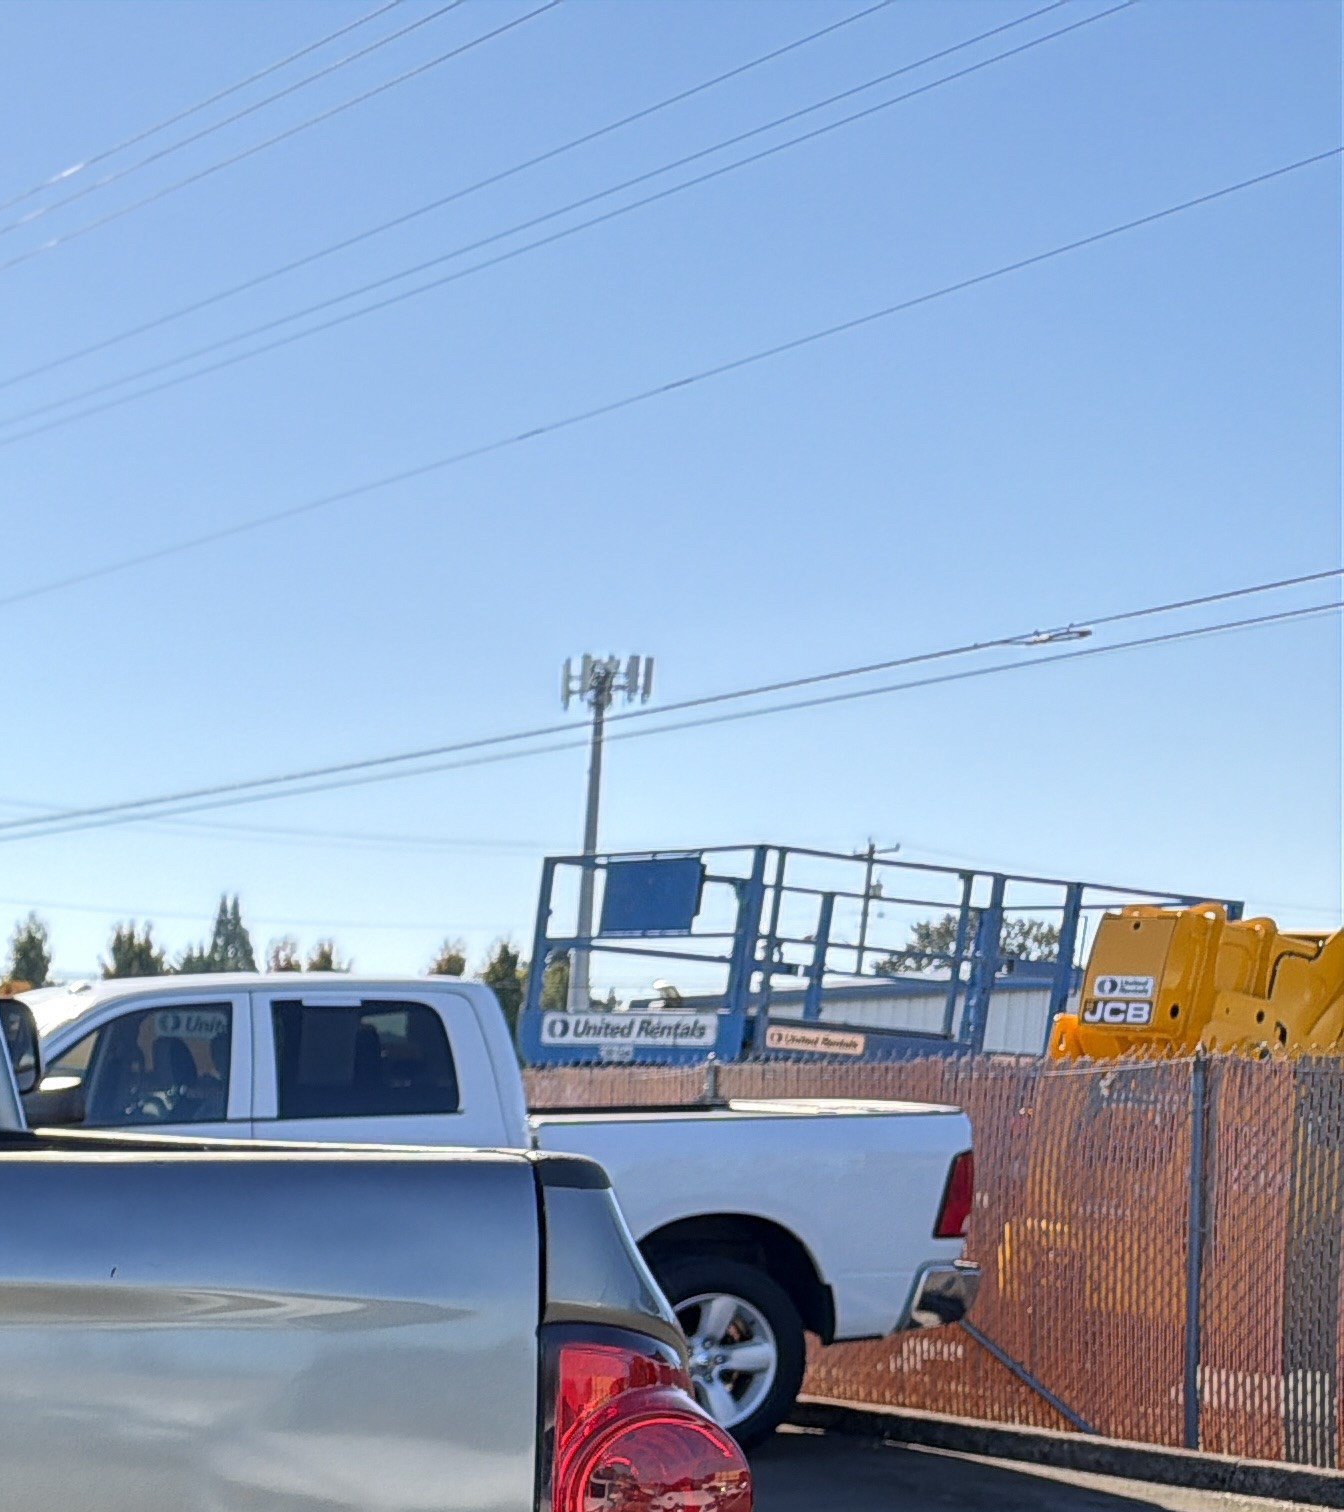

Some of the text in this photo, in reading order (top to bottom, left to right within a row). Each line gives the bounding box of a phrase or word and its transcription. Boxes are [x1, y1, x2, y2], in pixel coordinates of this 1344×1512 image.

[1084, 1001, 1150, 1023] JCB
[573, 1017, 707, 1039] United Rentals
